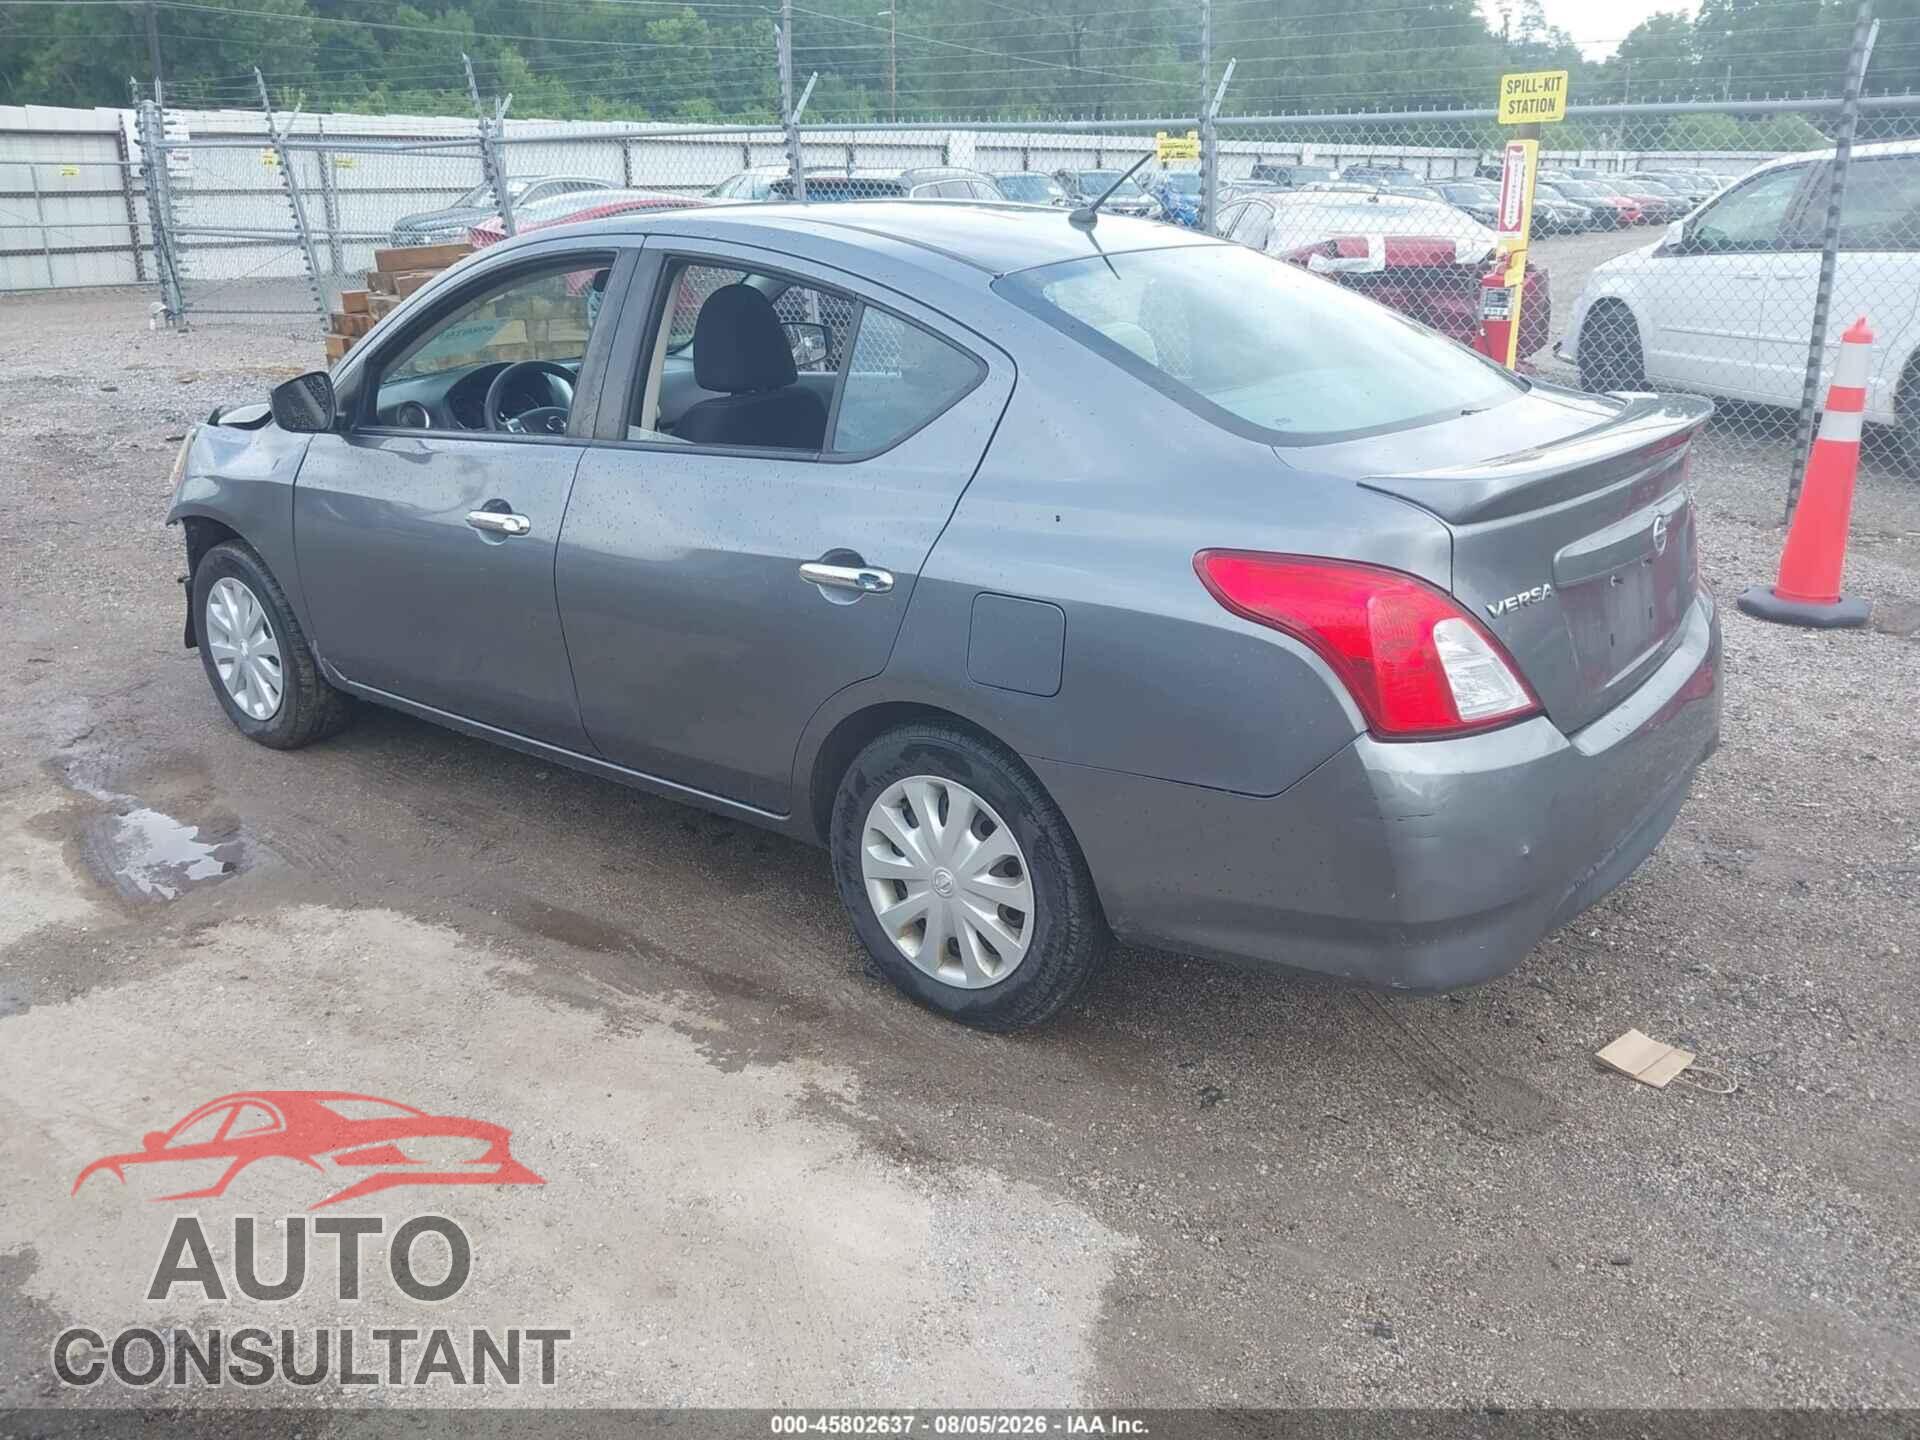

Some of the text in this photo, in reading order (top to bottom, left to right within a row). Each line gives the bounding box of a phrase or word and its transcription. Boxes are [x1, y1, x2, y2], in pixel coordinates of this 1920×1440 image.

[1506, 76, 1562, 94] SPILL-KIT
[1508, 97, 1556, 114] STATION
[1485, 583, 1553, 618] VERSA
